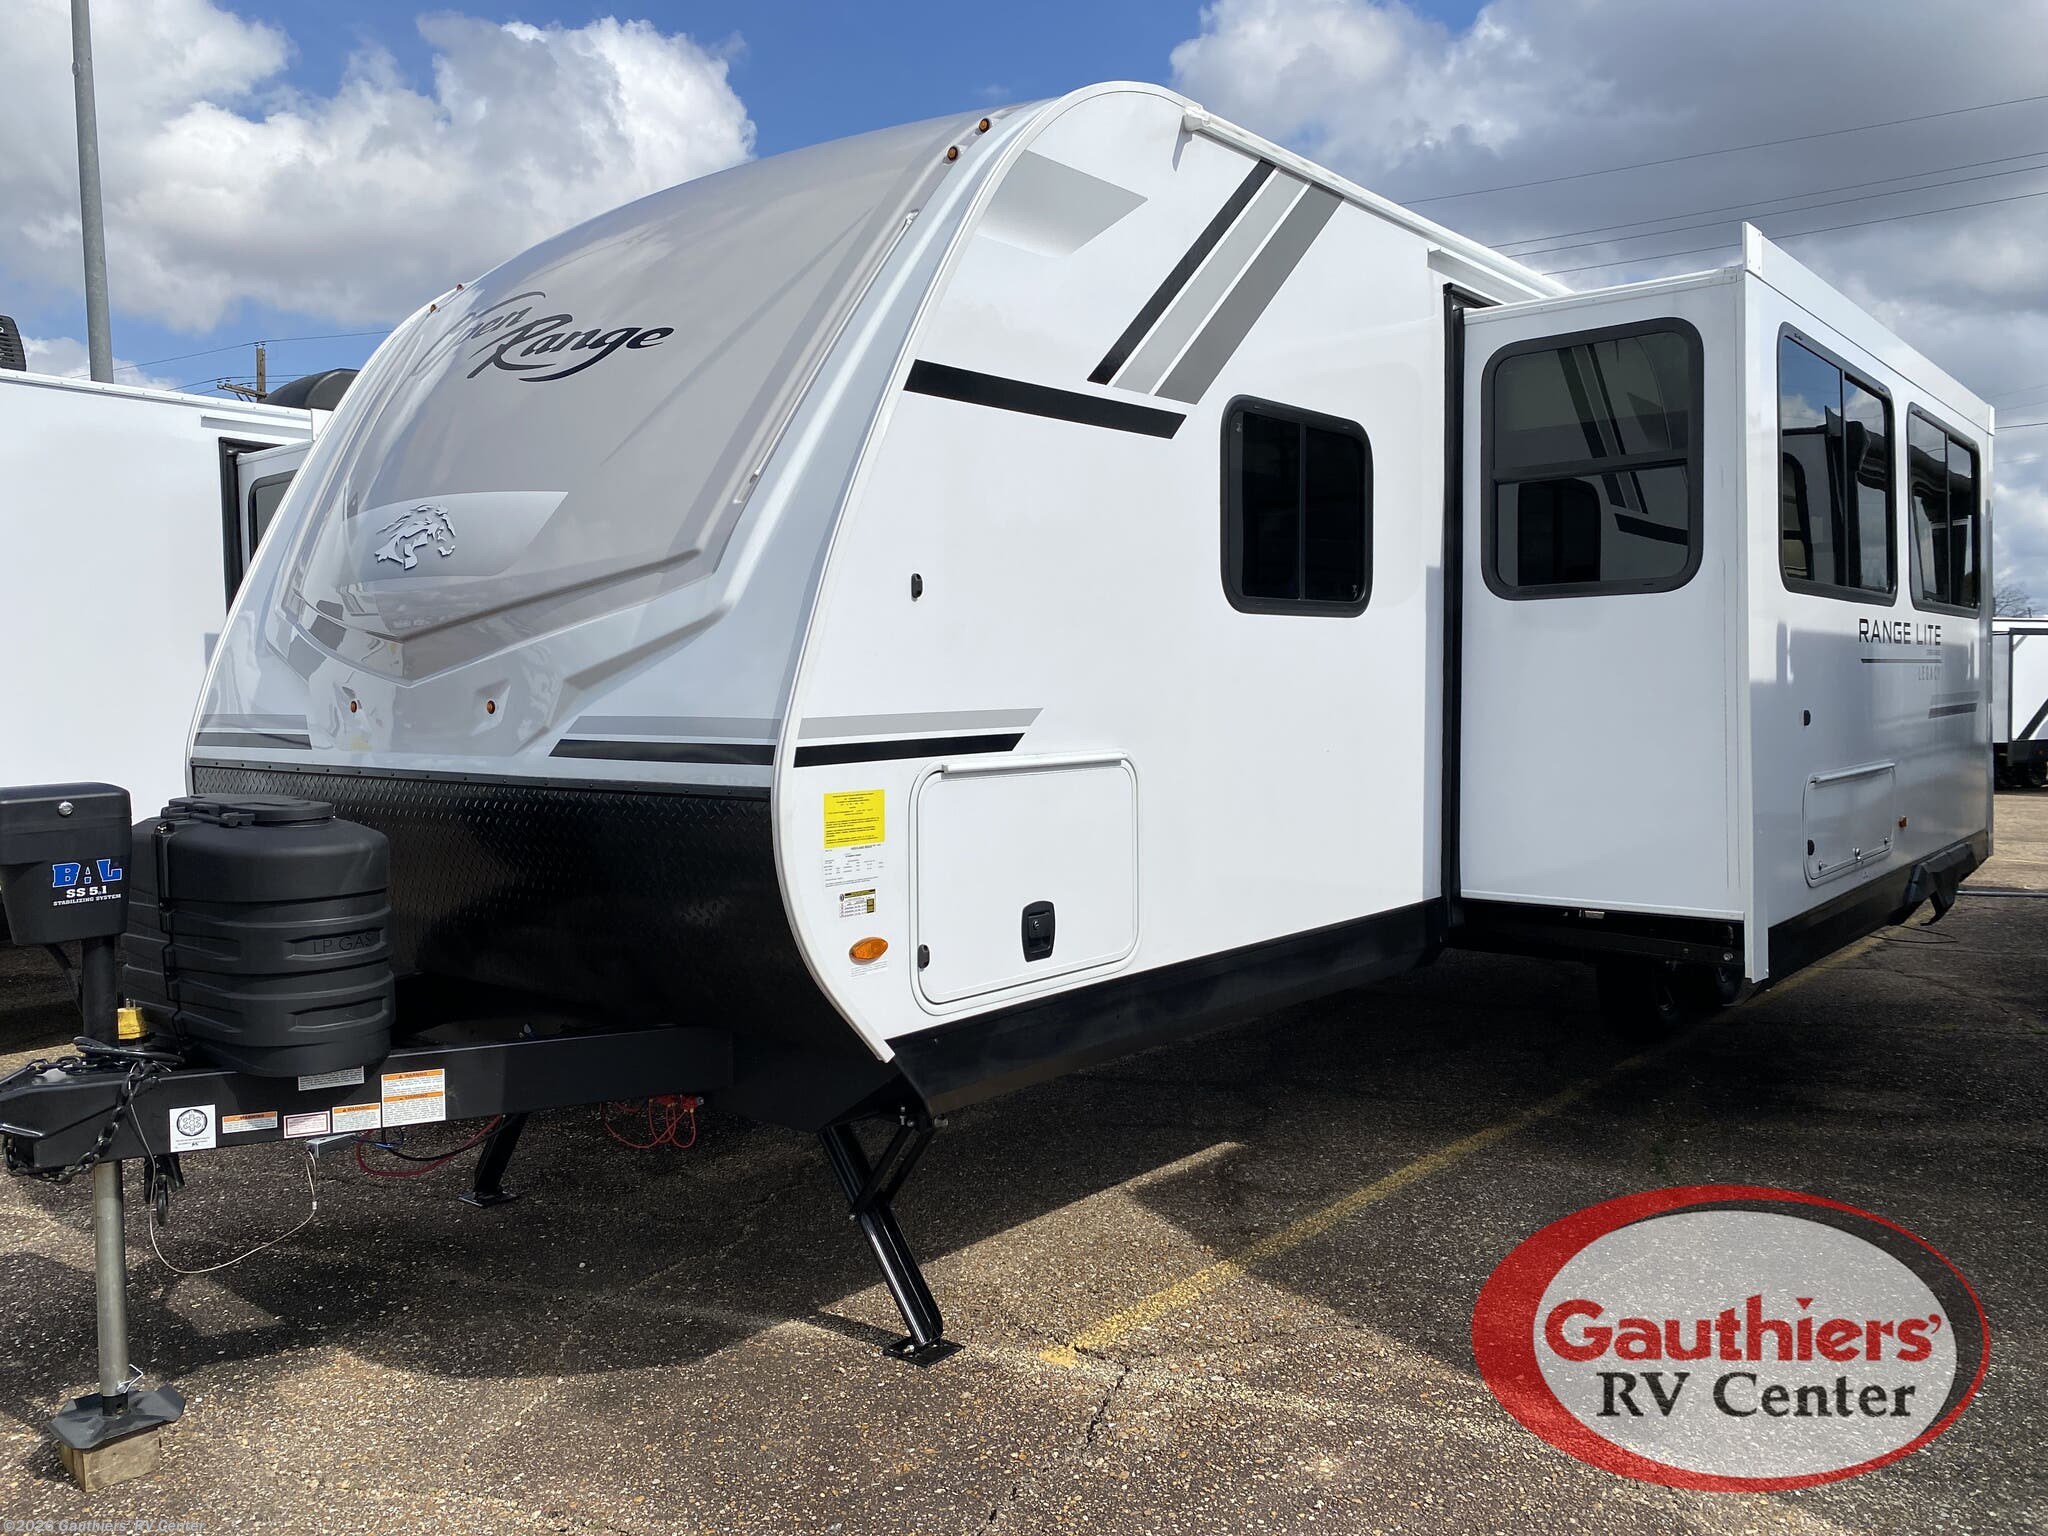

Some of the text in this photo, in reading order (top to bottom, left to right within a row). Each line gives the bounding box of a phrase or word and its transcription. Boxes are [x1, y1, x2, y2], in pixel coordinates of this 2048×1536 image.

[467, 314, 675, 382] Range
[1859, 618, 1941, 646] RANGE LITE
[53, 893, 121, 906] STABILIZING SYSTEM
[66, 885, 107, 898] SS 5.1
[312, 930, 375, 954] LP GAS
